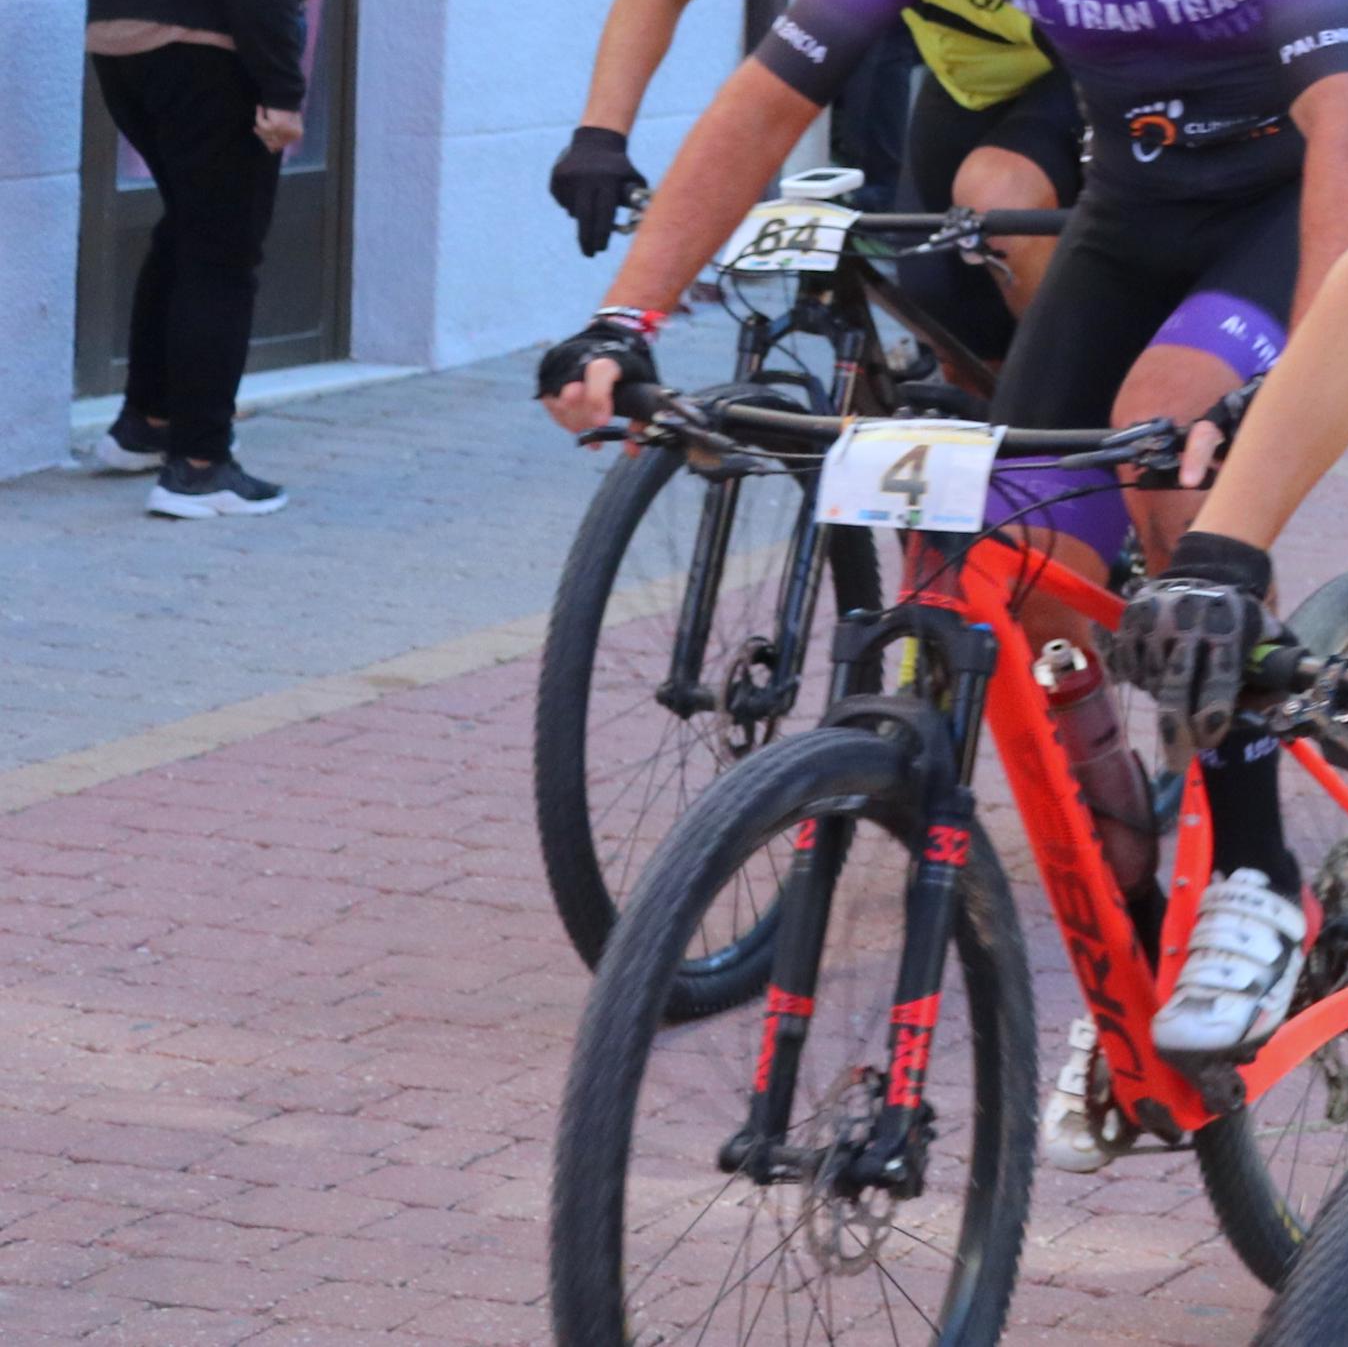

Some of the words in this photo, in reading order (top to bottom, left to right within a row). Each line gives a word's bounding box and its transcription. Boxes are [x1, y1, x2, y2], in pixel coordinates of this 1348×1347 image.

[752, 216, 819, 256] 64
[880, 443, 933, 508] 4
[923, 824, 972, 866] 32
